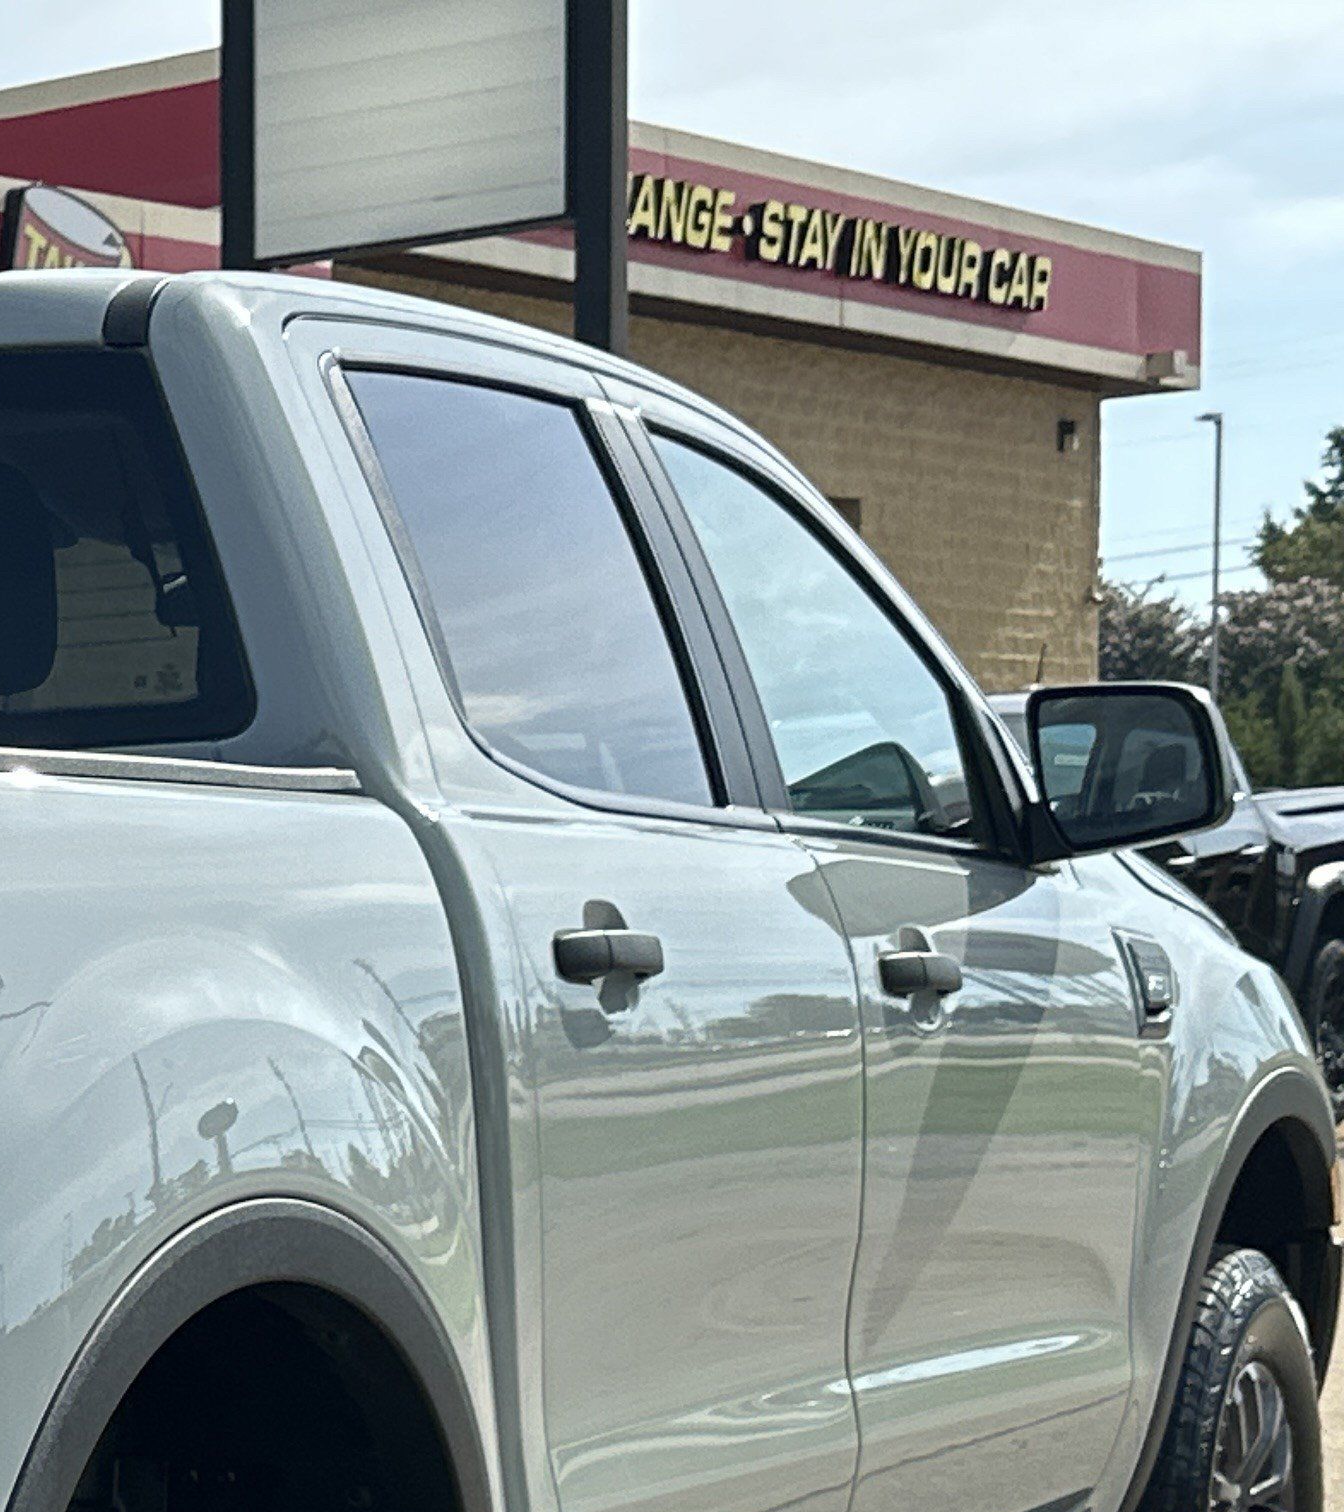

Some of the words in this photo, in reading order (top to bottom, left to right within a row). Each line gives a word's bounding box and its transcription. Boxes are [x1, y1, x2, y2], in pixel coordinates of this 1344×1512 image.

[626, 171, 736, 253] ANGE
[758, 200, 846, 271] STAY
[850, 218, 889, 279] IN
[898, 226, 981, 300] YOUR
[987, 248, 1052, 311] CAR
